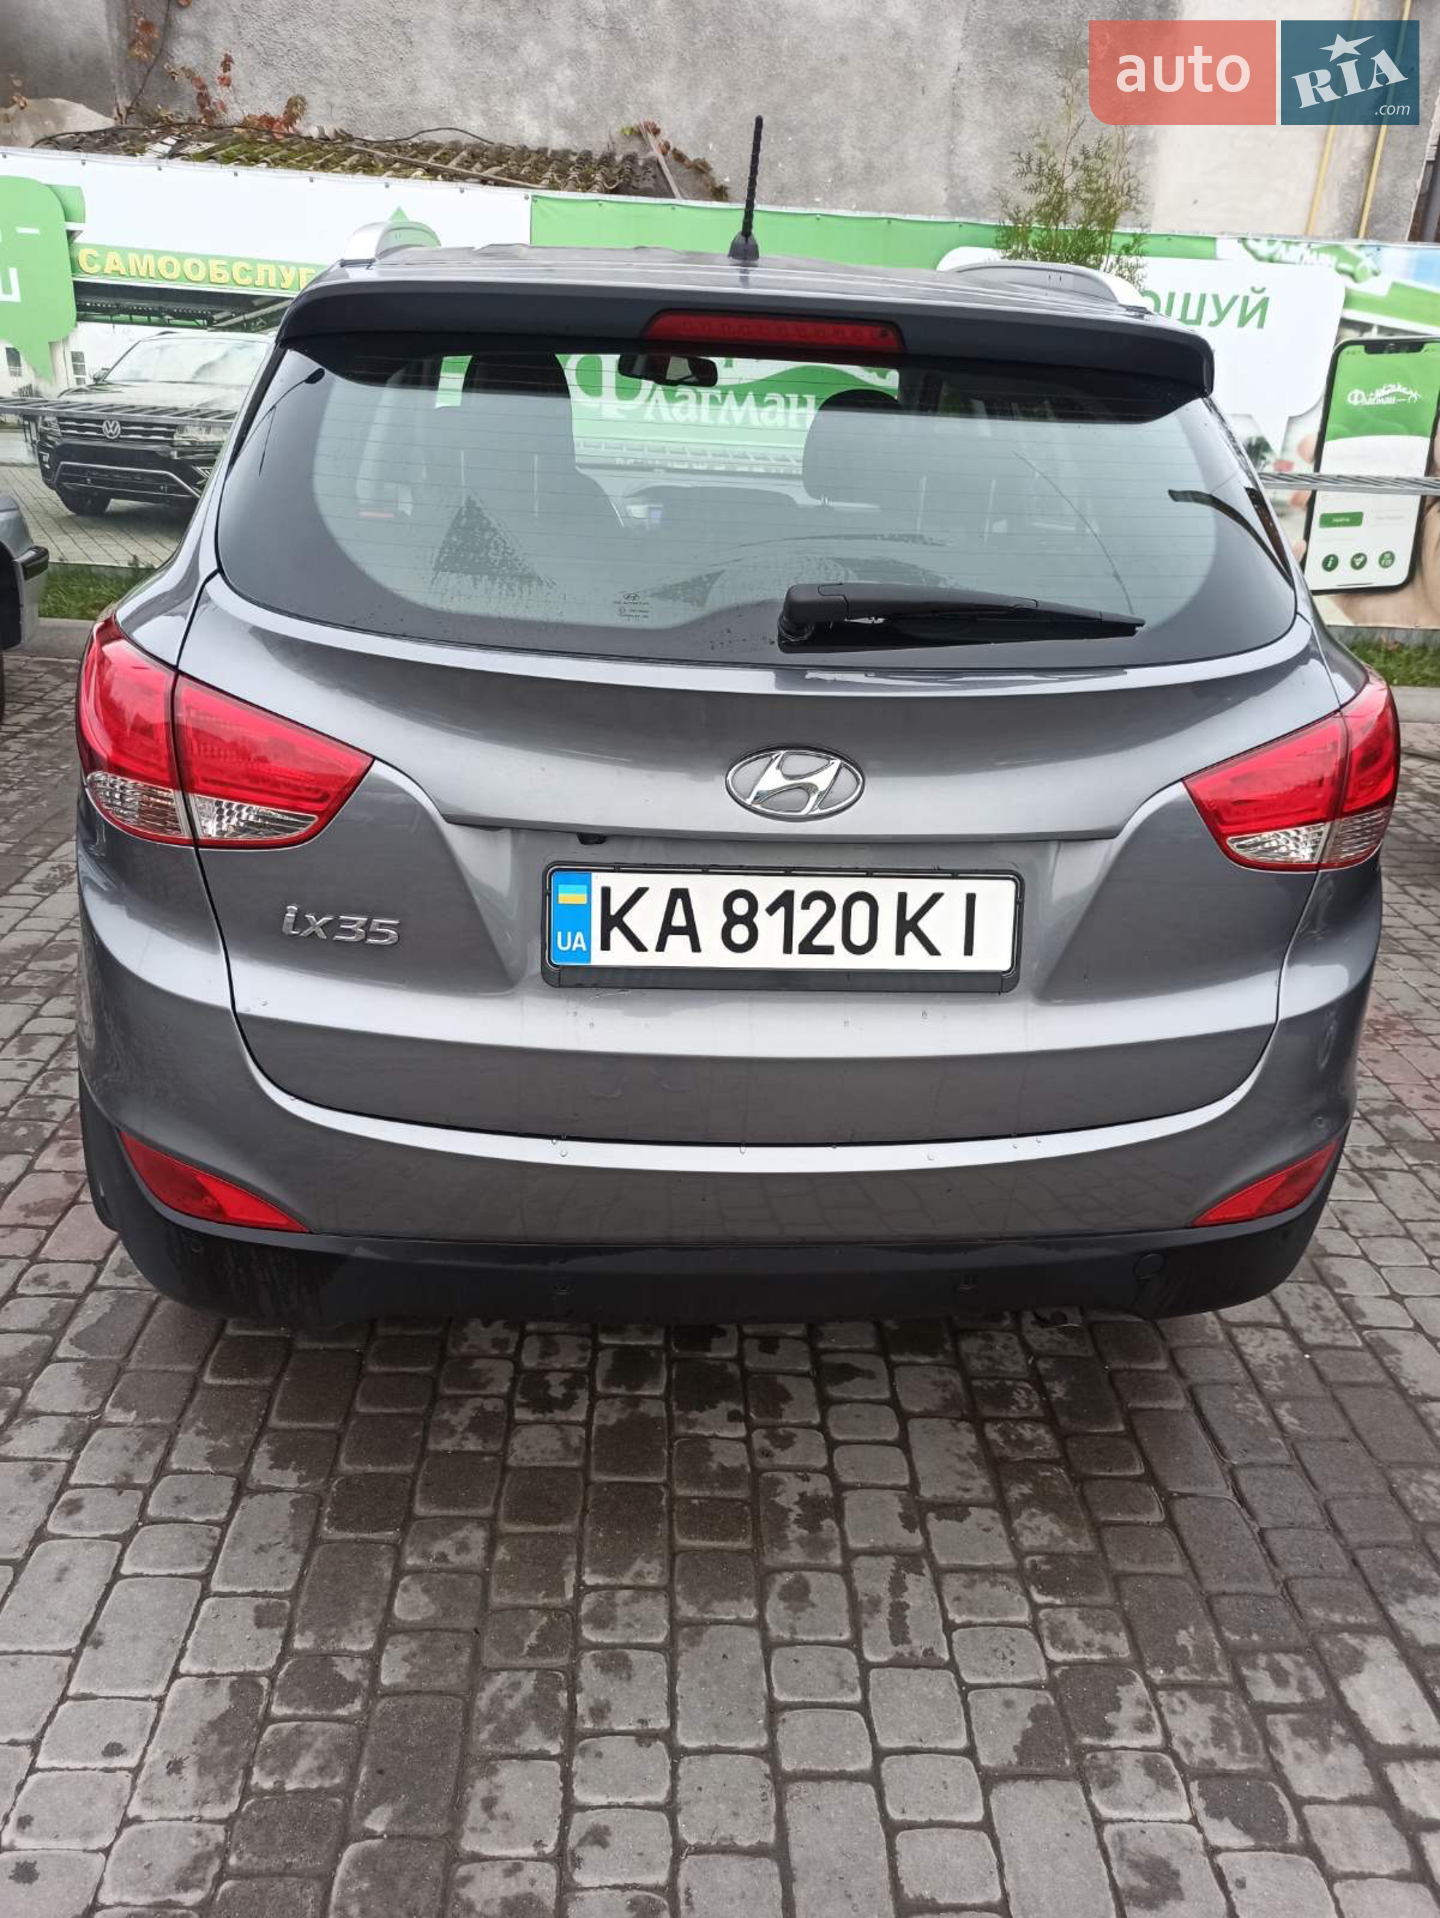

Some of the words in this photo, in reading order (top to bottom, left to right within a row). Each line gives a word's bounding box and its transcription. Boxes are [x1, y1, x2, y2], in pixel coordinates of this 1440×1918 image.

[282, 904, 400, 946] ix35
[556, 931, 587, 952] UA
[721, 889, 880, 956] 8120
